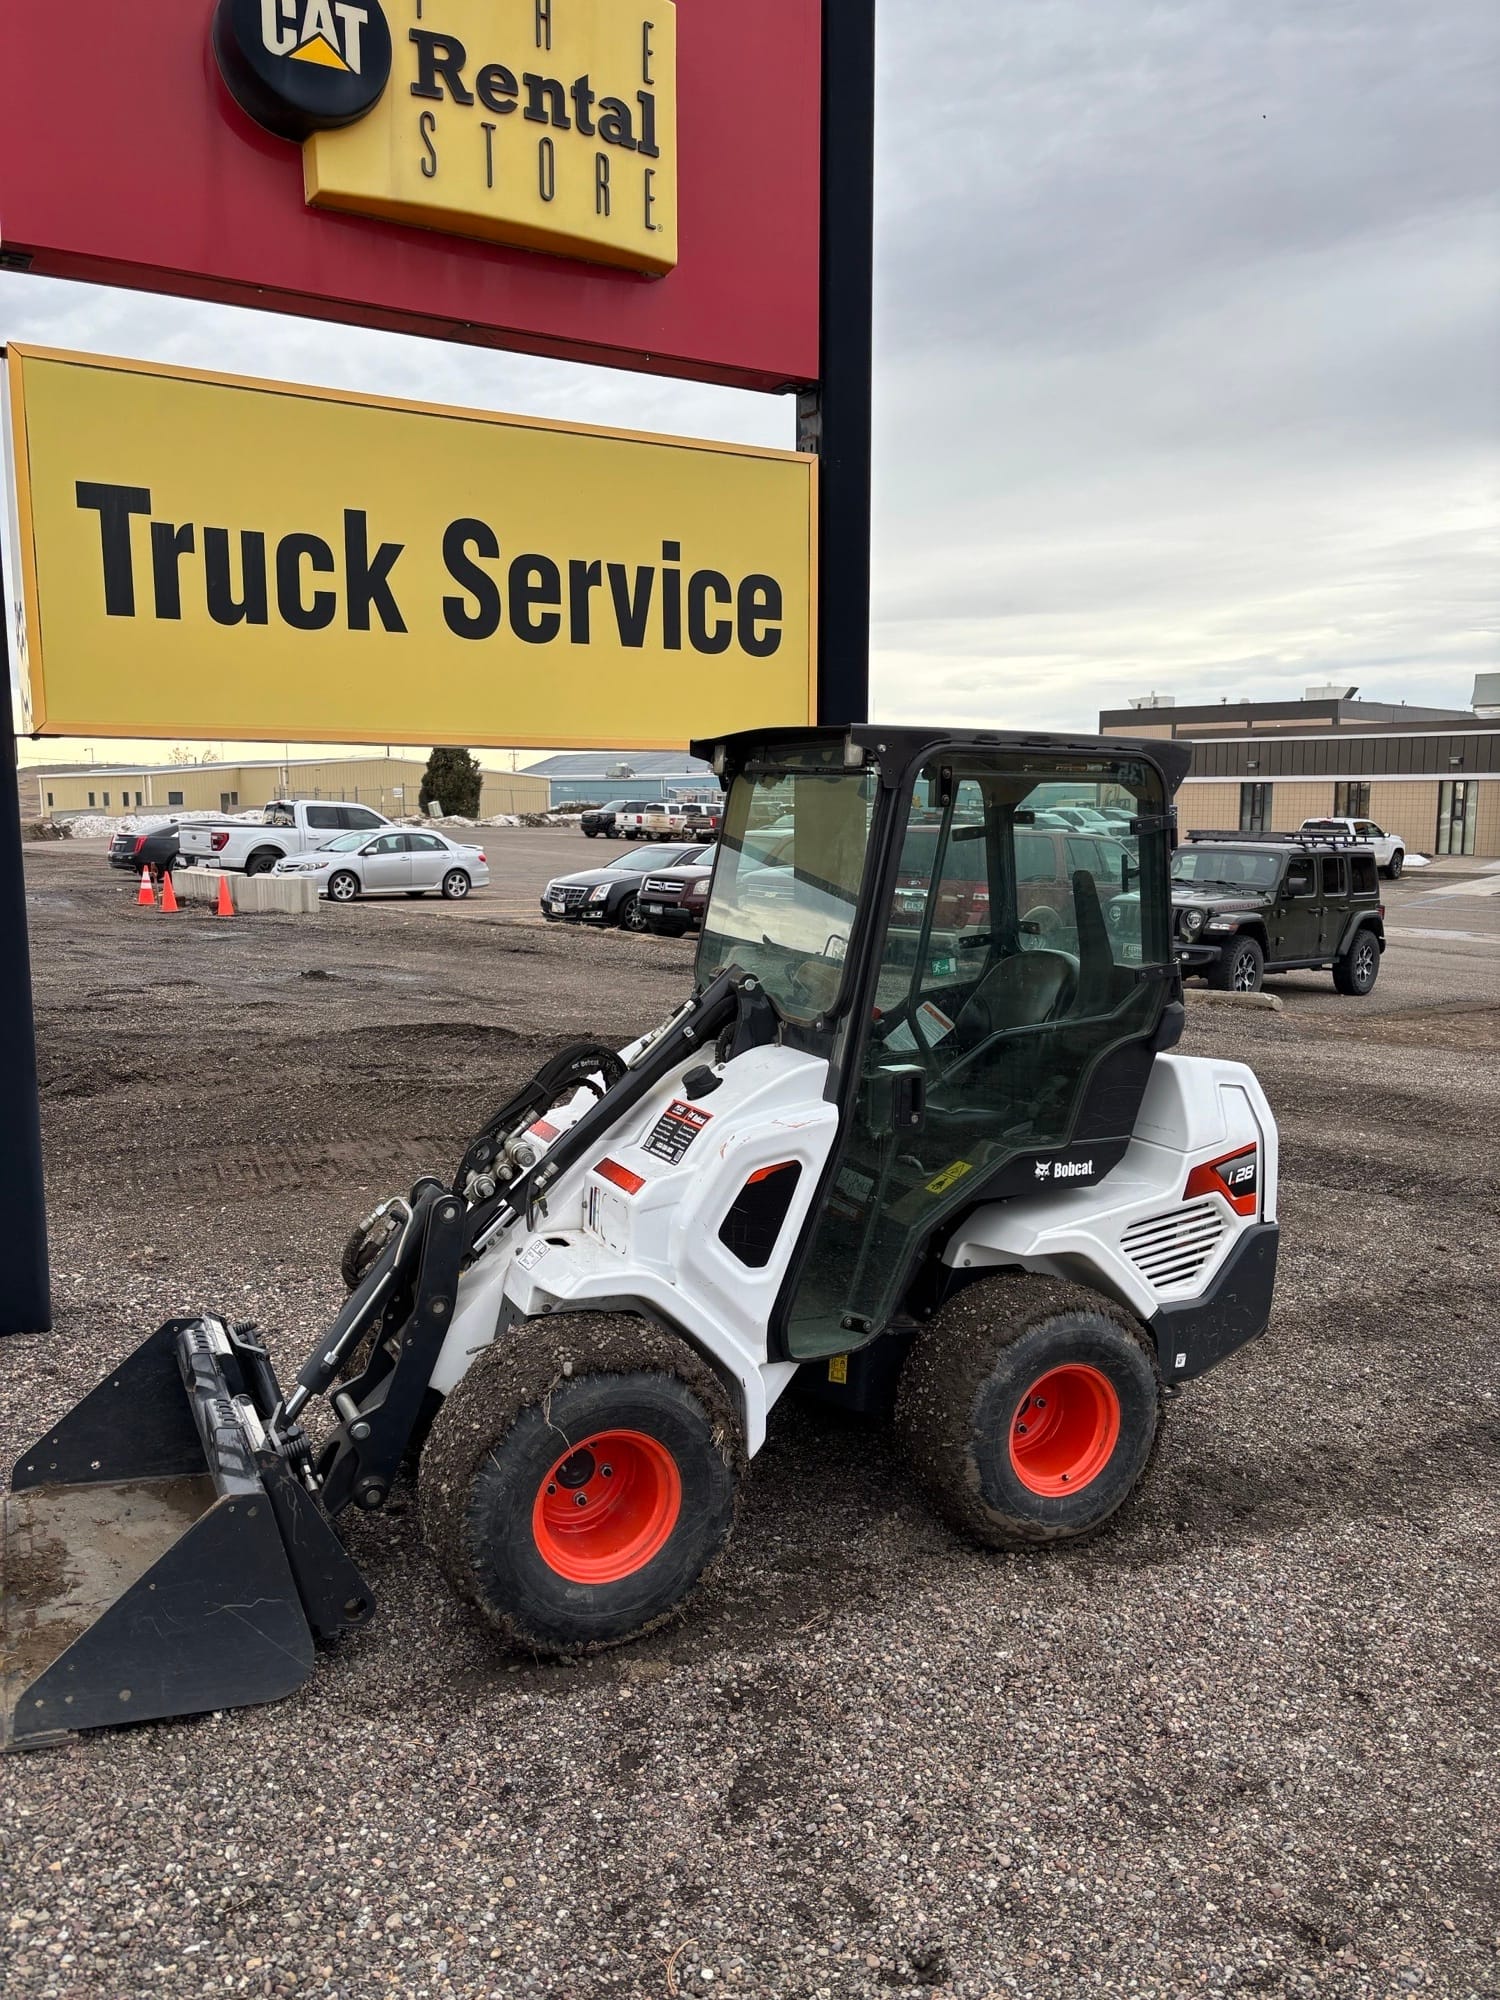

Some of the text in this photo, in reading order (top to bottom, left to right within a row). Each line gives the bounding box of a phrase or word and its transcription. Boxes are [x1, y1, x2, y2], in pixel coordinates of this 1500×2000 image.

[261, 0, 368, 75] CAT
[415, 0, 655, 85] HE
[409, 28, 660, 158] Rental
[419, 110, 657, 231] STORE
[76, 481, 783, 658] Truck Service
[1054, 1160, 1094, 1178] Bobcat
